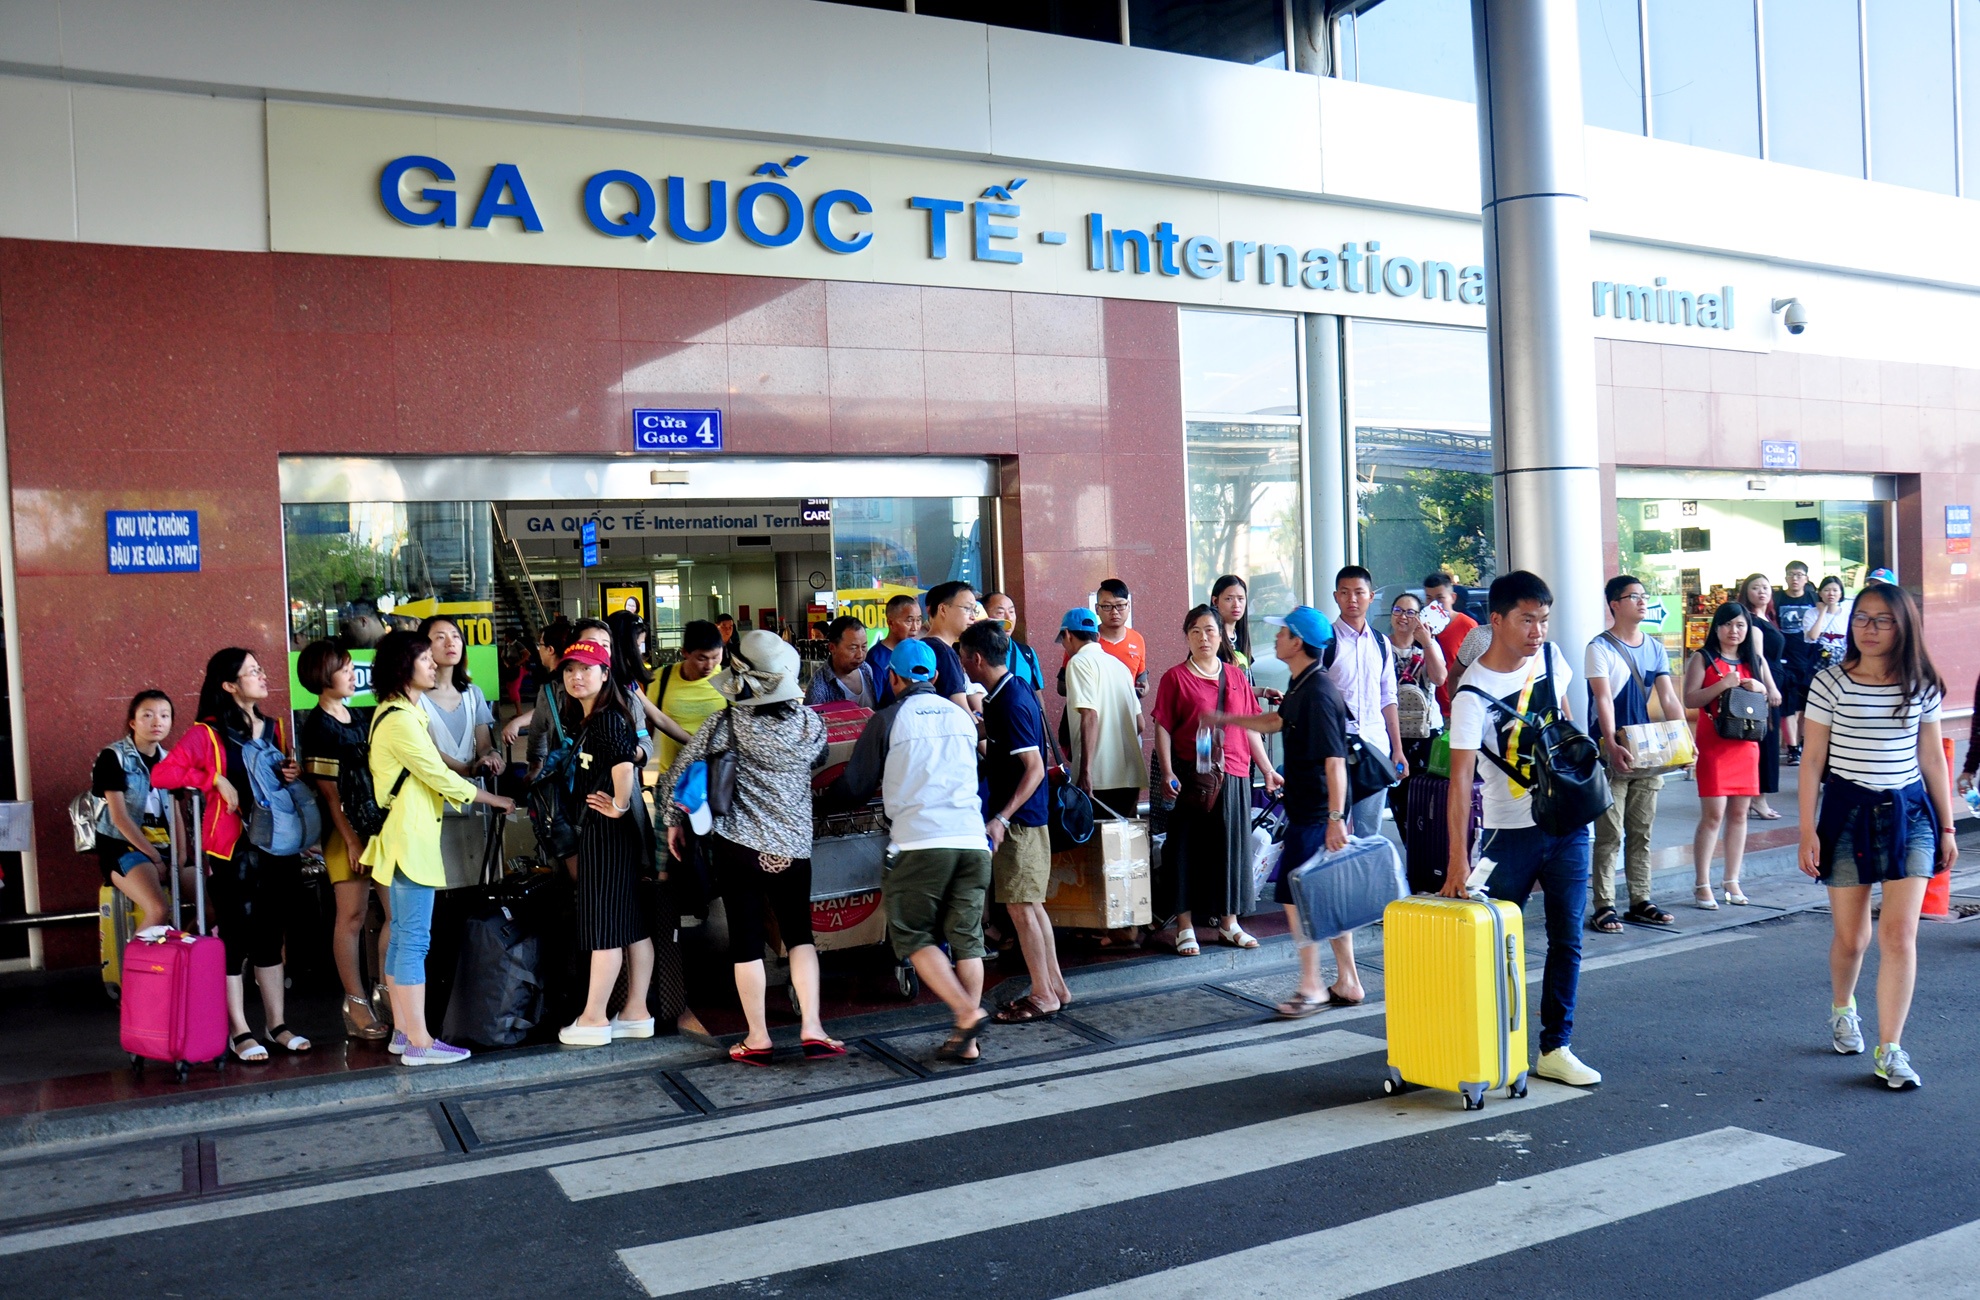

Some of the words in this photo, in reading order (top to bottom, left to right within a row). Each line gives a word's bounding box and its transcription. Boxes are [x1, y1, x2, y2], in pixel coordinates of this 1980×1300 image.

[379, 155, 545, 233] GA
[583, 155, 874, 256] QUỐC
[910, 178, 1028, 265] TẾ
[1086, 212, 1486, 304] Internationa
[1592, 277, 1735, 331] rminal
[642, 415, 688, 429] Cửa
[695, 416, 714, 444] 4
[643, 431, 688, 444] Gate
[1765, 455, 1785, 464] Gate
[1787, 446, 1796, 464] 5
[803, 510, 831, 521] CARD
[1645, 505, 1658, 518] 34
[1682, 502, 1696, 516] 33
[116, 516, 136, 537] KHU
[137, 512, 157, 541] VỰC
[157, 512, 190, 536] KHÔNG
[527, 517, 555, 532] GA
[110, 541, 131, 570] ĐẬU
[131, 545, 146, 566] XE
[166, 544, 174, 566] 3
[173, 540, 198, 565] PHÚT
